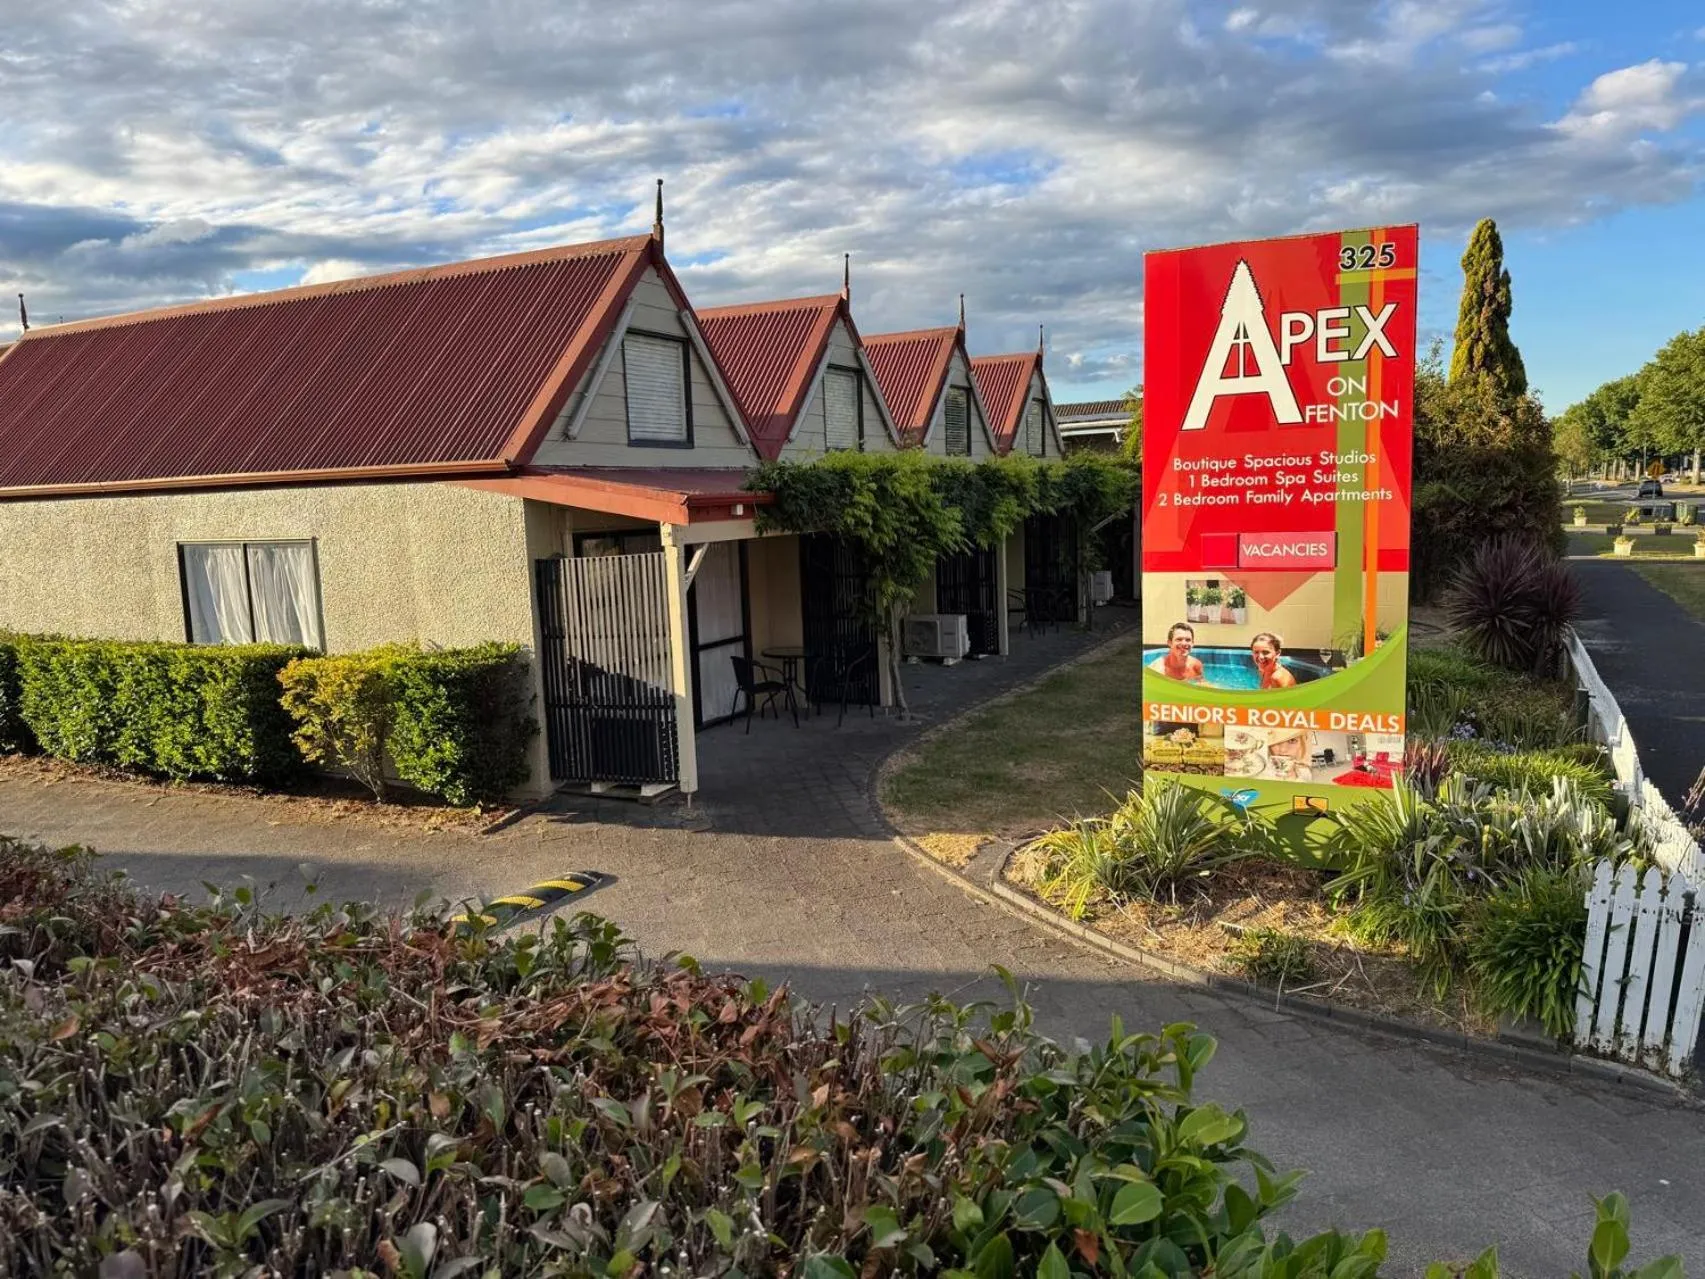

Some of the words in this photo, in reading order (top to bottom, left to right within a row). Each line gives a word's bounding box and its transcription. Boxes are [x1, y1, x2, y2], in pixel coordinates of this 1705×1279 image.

[1339, 243, 1396, 270] 325
[1180, 256, 1399, 431] APEX
[1327, 376, 1366, 396] ON
[1305, 400, 1399, 424] FENTON
[1173, 458, 1237, 472] Boutique
[1244, 454, 1312, 471] Spacious
[1319, 451, 1377, 466] Studios
[1188, 475, 1195, 488] 1
[1201, 473, 1268, 487] Bedroom
[1275, 471, 1306, 487] Spa
[1313, 469, 1359, 483] Suites
[1158, 493, 1167, 506] 2
[1173, 493, 1239, 506] Bedroom
[1246, 489, 1294, 506] Family
[1301, 487, 1393, 504] Apartments
[1242, 543, 1328, 557] VACANCIES
[1150, 703, 1237, 724] SENIORS
[1248, 708, 1319, 728] ROYAL
[1330, 712, 1400, 733] DEALS
